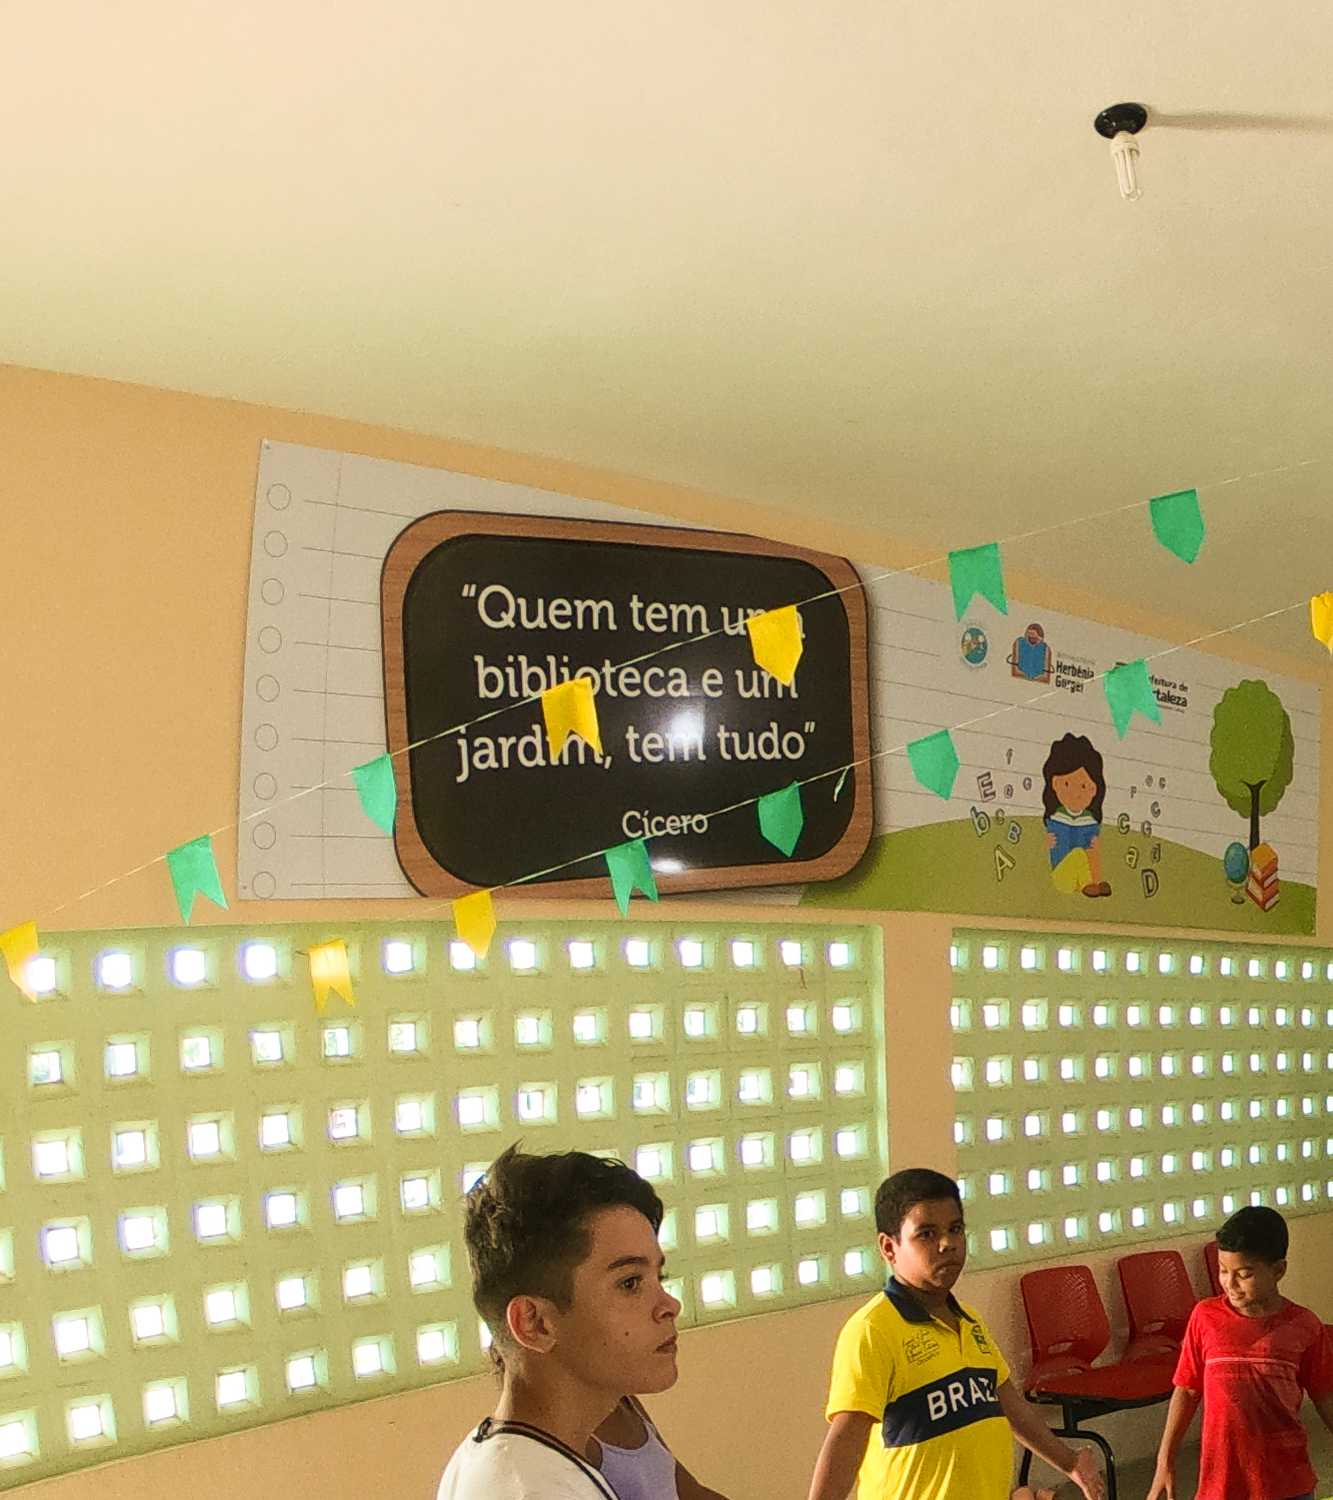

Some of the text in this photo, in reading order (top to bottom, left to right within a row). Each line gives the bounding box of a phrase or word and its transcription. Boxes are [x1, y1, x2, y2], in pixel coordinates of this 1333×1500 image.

[462, 584, 617, 630] "Quem
[630, 594, 709, 633] tem
[474, 655, 798, 698] biblioteca e um
[456, 721, 816, 783] jardm, tem tudo"
[622, 811, 708, 839] Cícero
